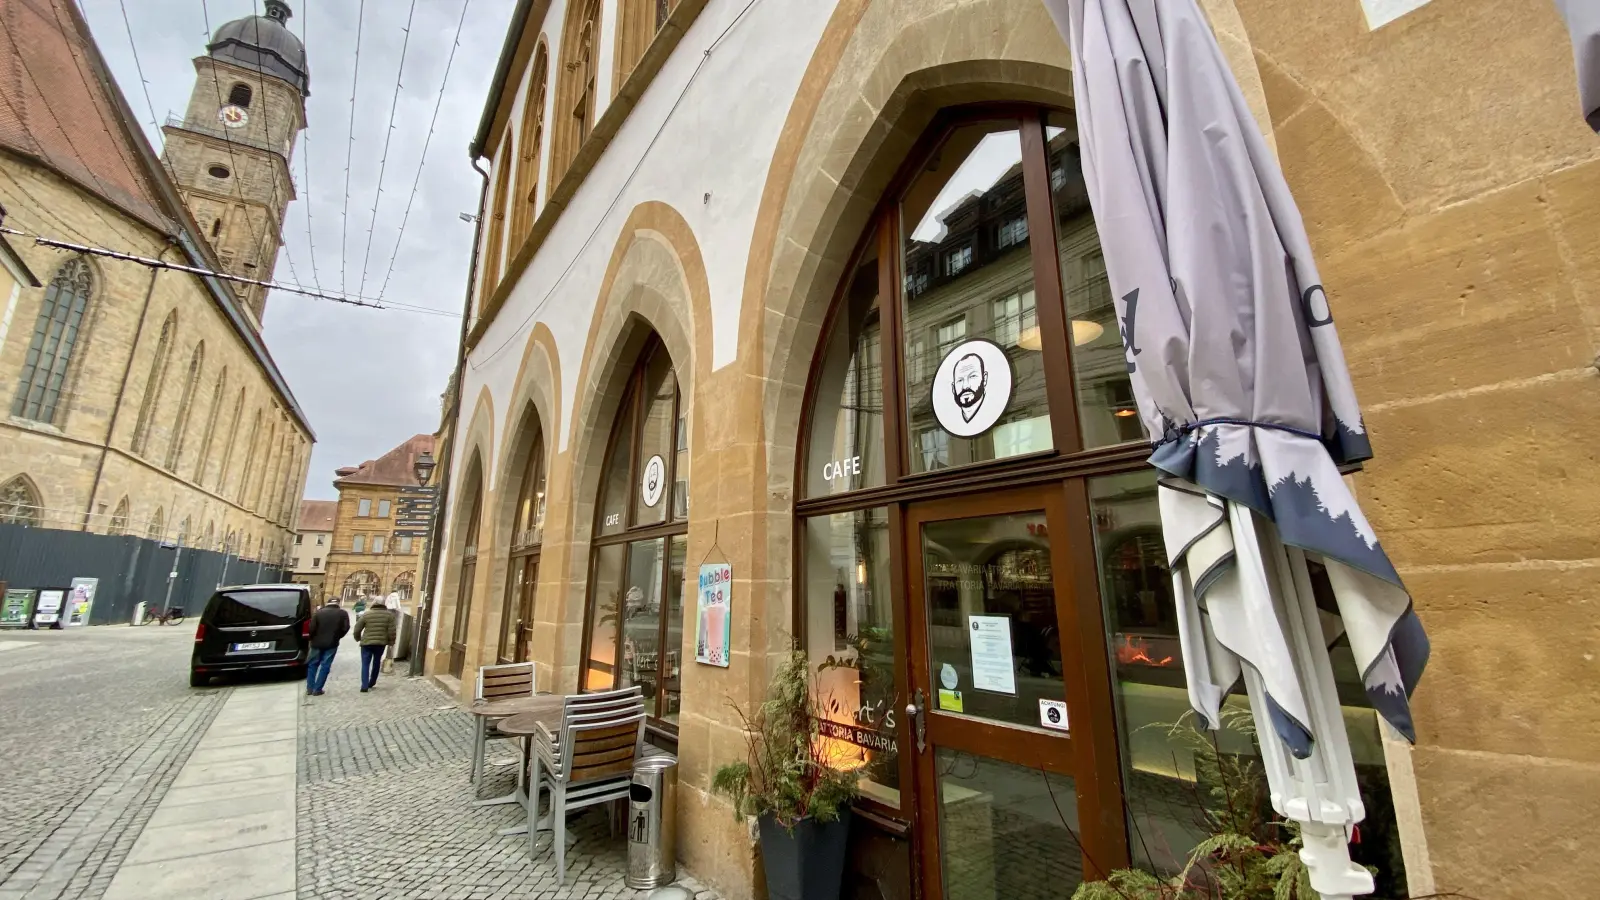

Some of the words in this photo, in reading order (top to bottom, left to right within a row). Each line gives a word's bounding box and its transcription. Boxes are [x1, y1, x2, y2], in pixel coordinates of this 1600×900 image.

[823, 456, 860, 480] CAFE
[606, 513, 619, 526] CAFE
[699, 568, 730, 588] Bubble
[705, 590, 724, 605] Tea
[857, 731, 898, 753] BAVARIA
